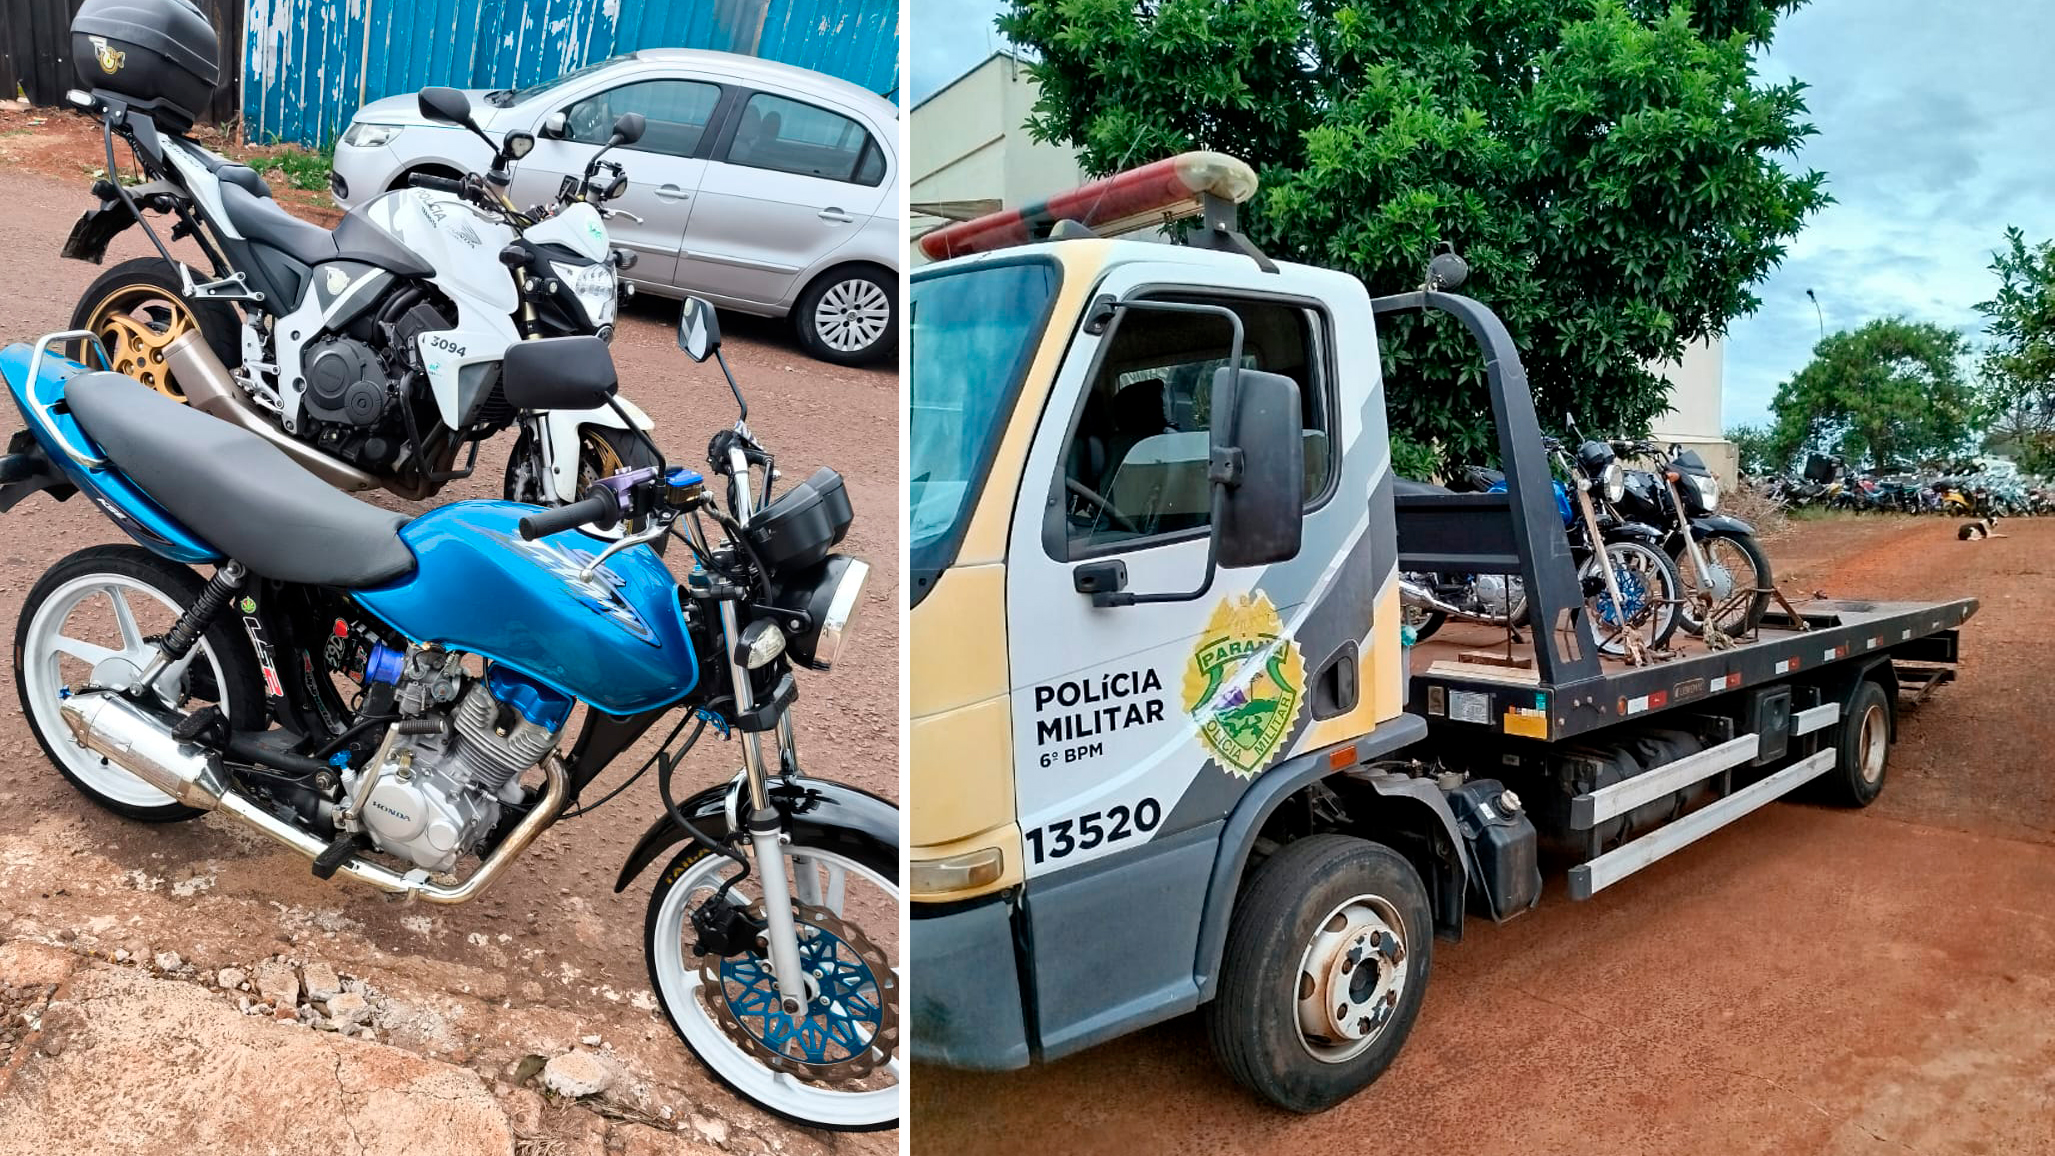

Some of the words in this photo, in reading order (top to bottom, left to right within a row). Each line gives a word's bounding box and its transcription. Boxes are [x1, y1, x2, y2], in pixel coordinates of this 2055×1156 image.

[1035, 668, 1162, 712] POLÍCIA
[1037, 699, 1164, 746] MILITAR
[1205, 719, 1242, 761] OLICIA
[1255, 696, 1291, 755] MILITAR
[1064, 742, 1103, 763] BPM
[372, 801, 411, 821] HONDA
[1025, 797, 1161, 865] 13520
